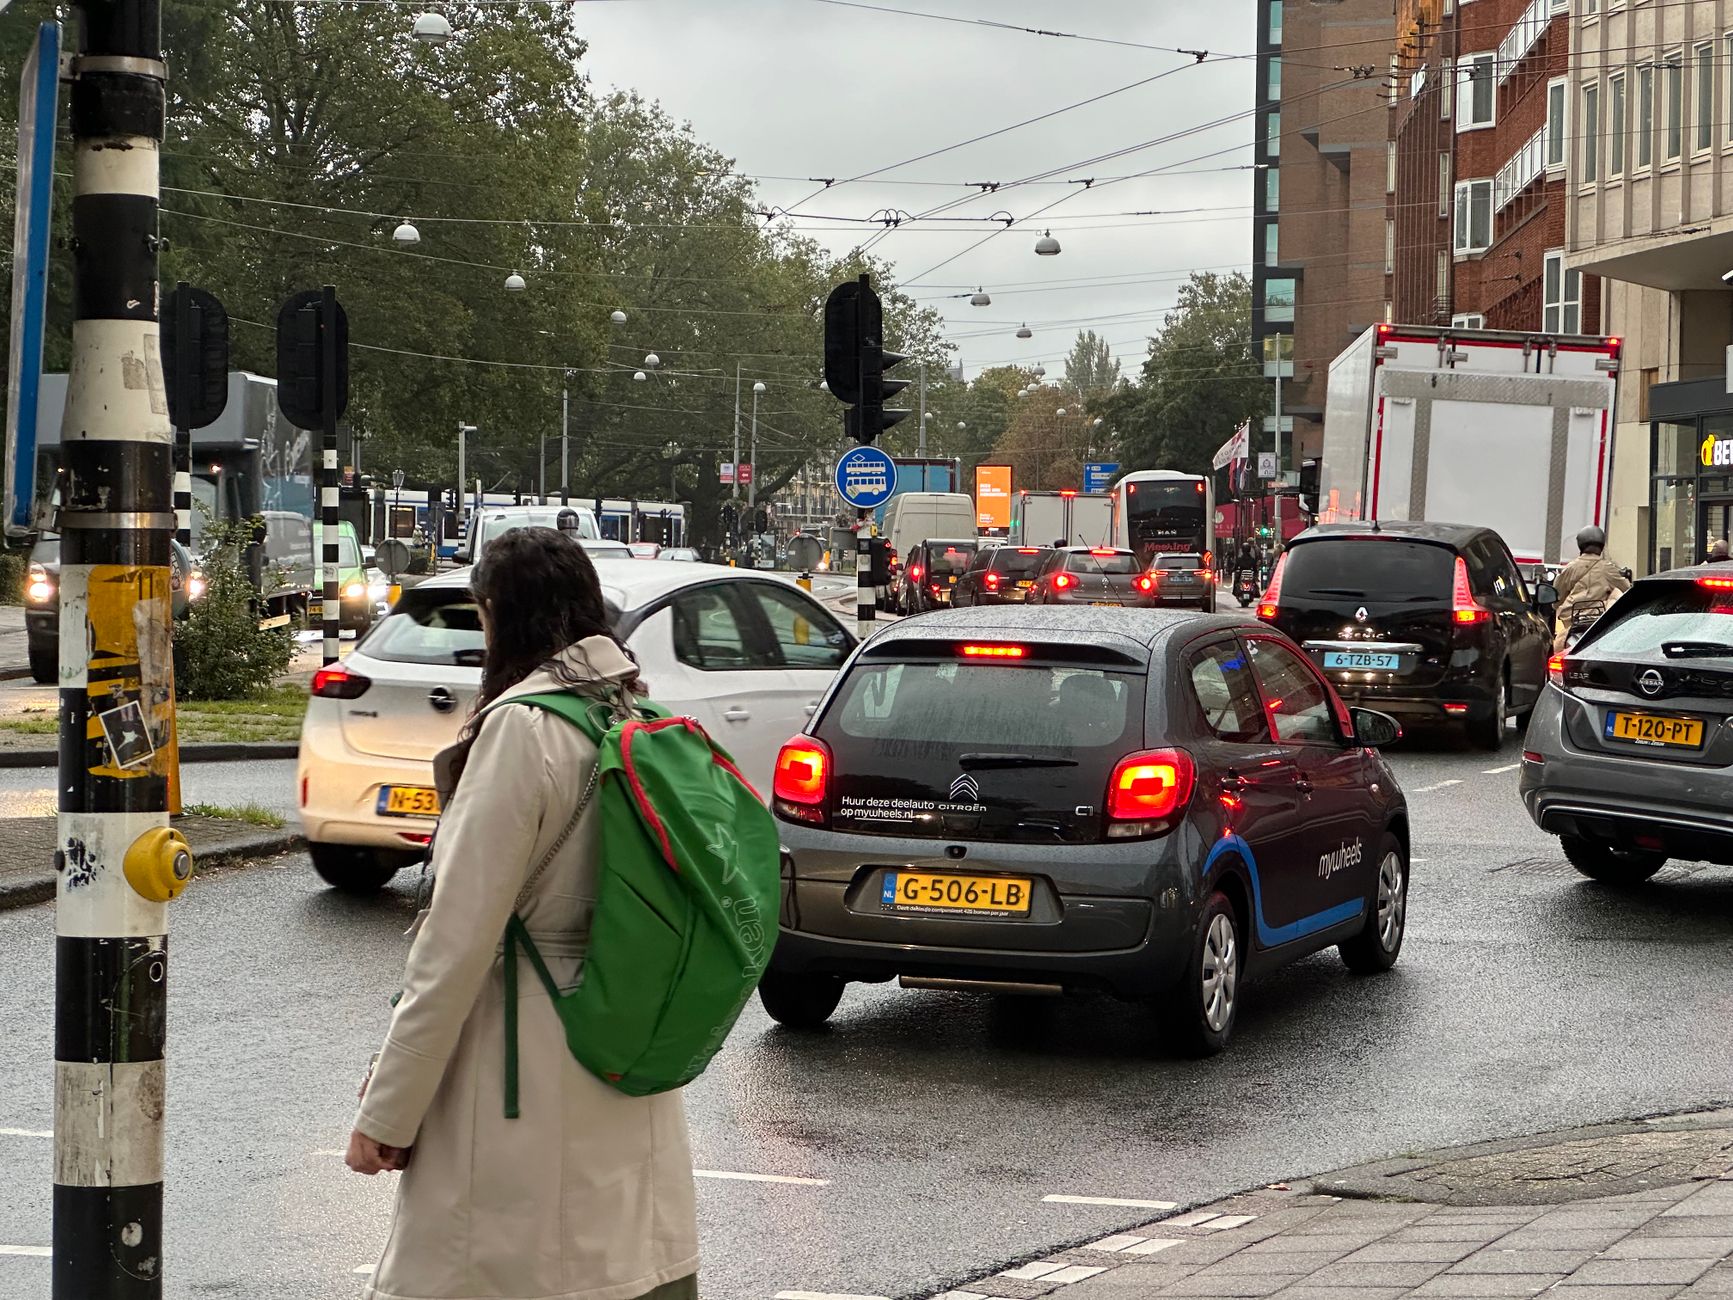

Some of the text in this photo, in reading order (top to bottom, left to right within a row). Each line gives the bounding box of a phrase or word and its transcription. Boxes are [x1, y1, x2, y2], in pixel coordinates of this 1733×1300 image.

[1714, 440, 1733, 466] BE
[1335, 654, 1393, 668] 6-TZB-57
[1568, 672, 1590, 680] LEAF
[1639, 679, 1664, 687] NISSAN
[1622, 717, 1693, 741] T-120-PT
[391, 791, 440, 811] N-53
[842, 796, 935, 810] Huur deze deelauto
[841, 808, 914, 819] op mywheels.nl
[1318, 836, 1363, 880] mywheels
[884, 878, 1022, 906] NL G-506-LB
